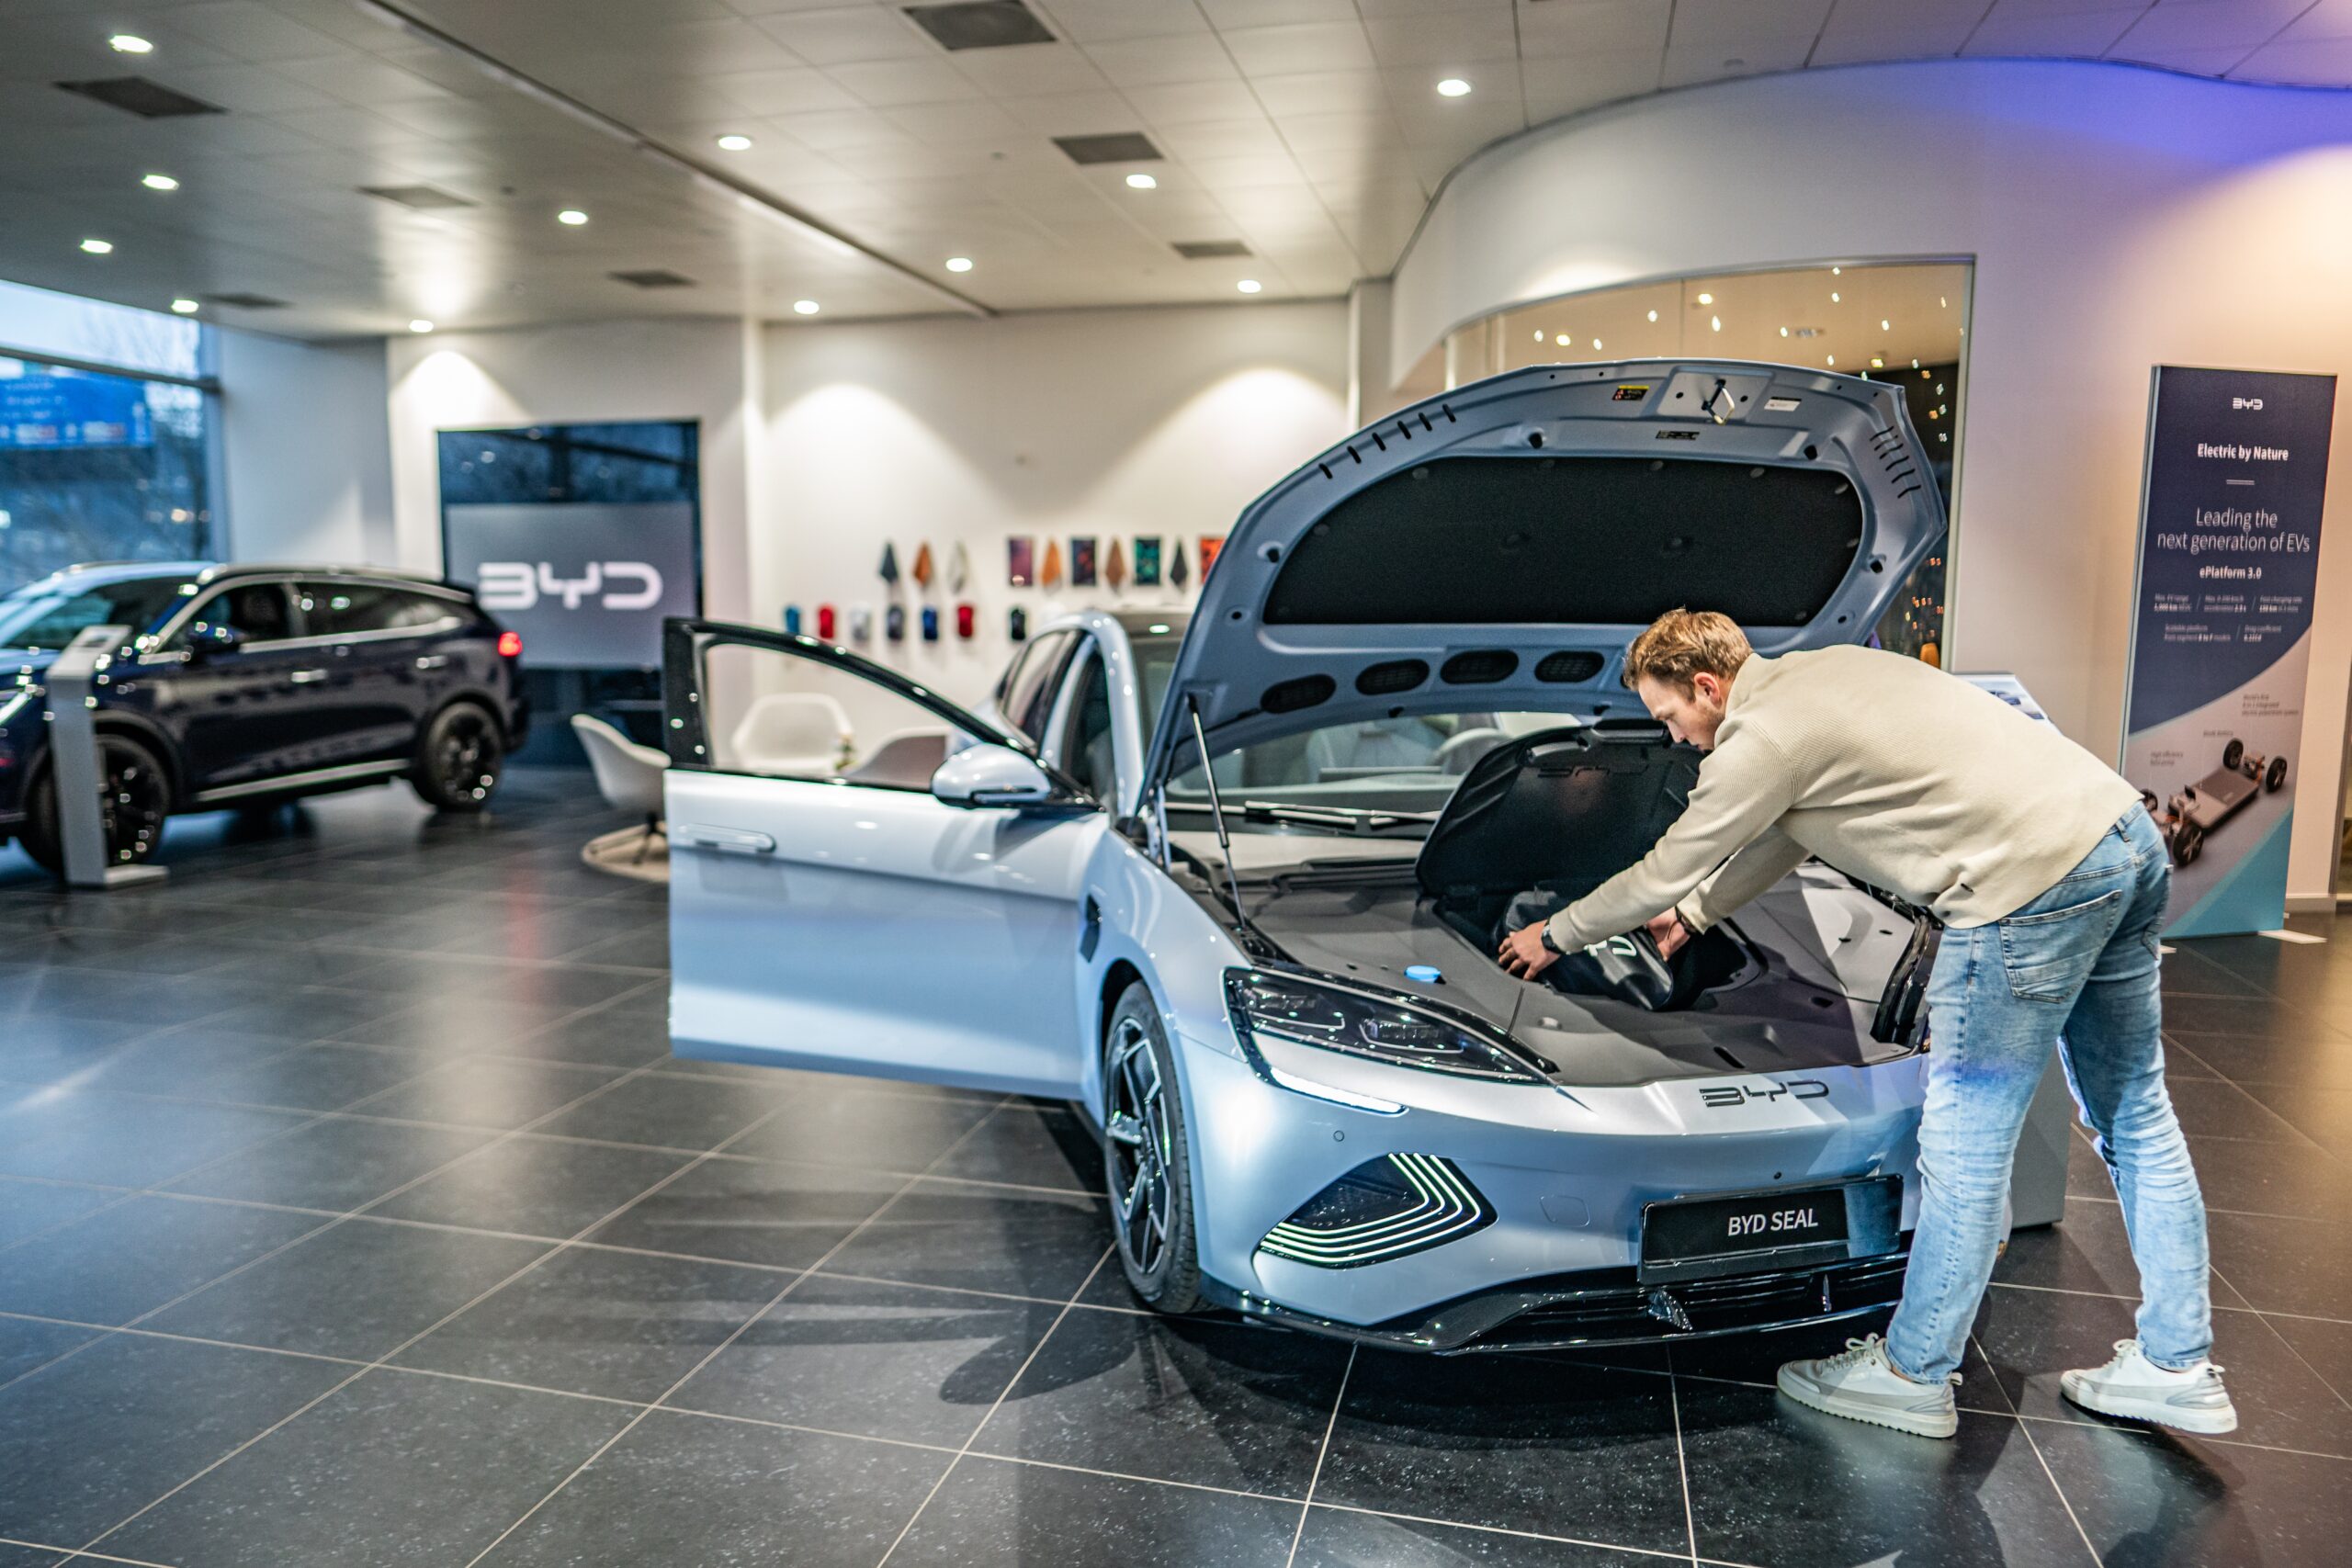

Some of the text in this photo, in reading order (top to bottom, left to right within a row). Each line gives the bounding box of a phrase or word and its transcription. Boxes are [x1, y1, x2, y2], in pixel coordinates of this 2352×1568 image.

[2233, 397, 2263, 411] BYD
[2197, 443, 2290, 462] Electric by Nature
[2196, 507, 2278, 533] Leading the
[2157, 530, 2311, 555] next generation of EVs
[2199, 565, 2262, 580] ePlatform 3.0
[478, 561, 663, 610] BYD
[1699, 1079, 1829, 1108] BYD
[1727, 1208, 1819, 1236] BYD SEAL
